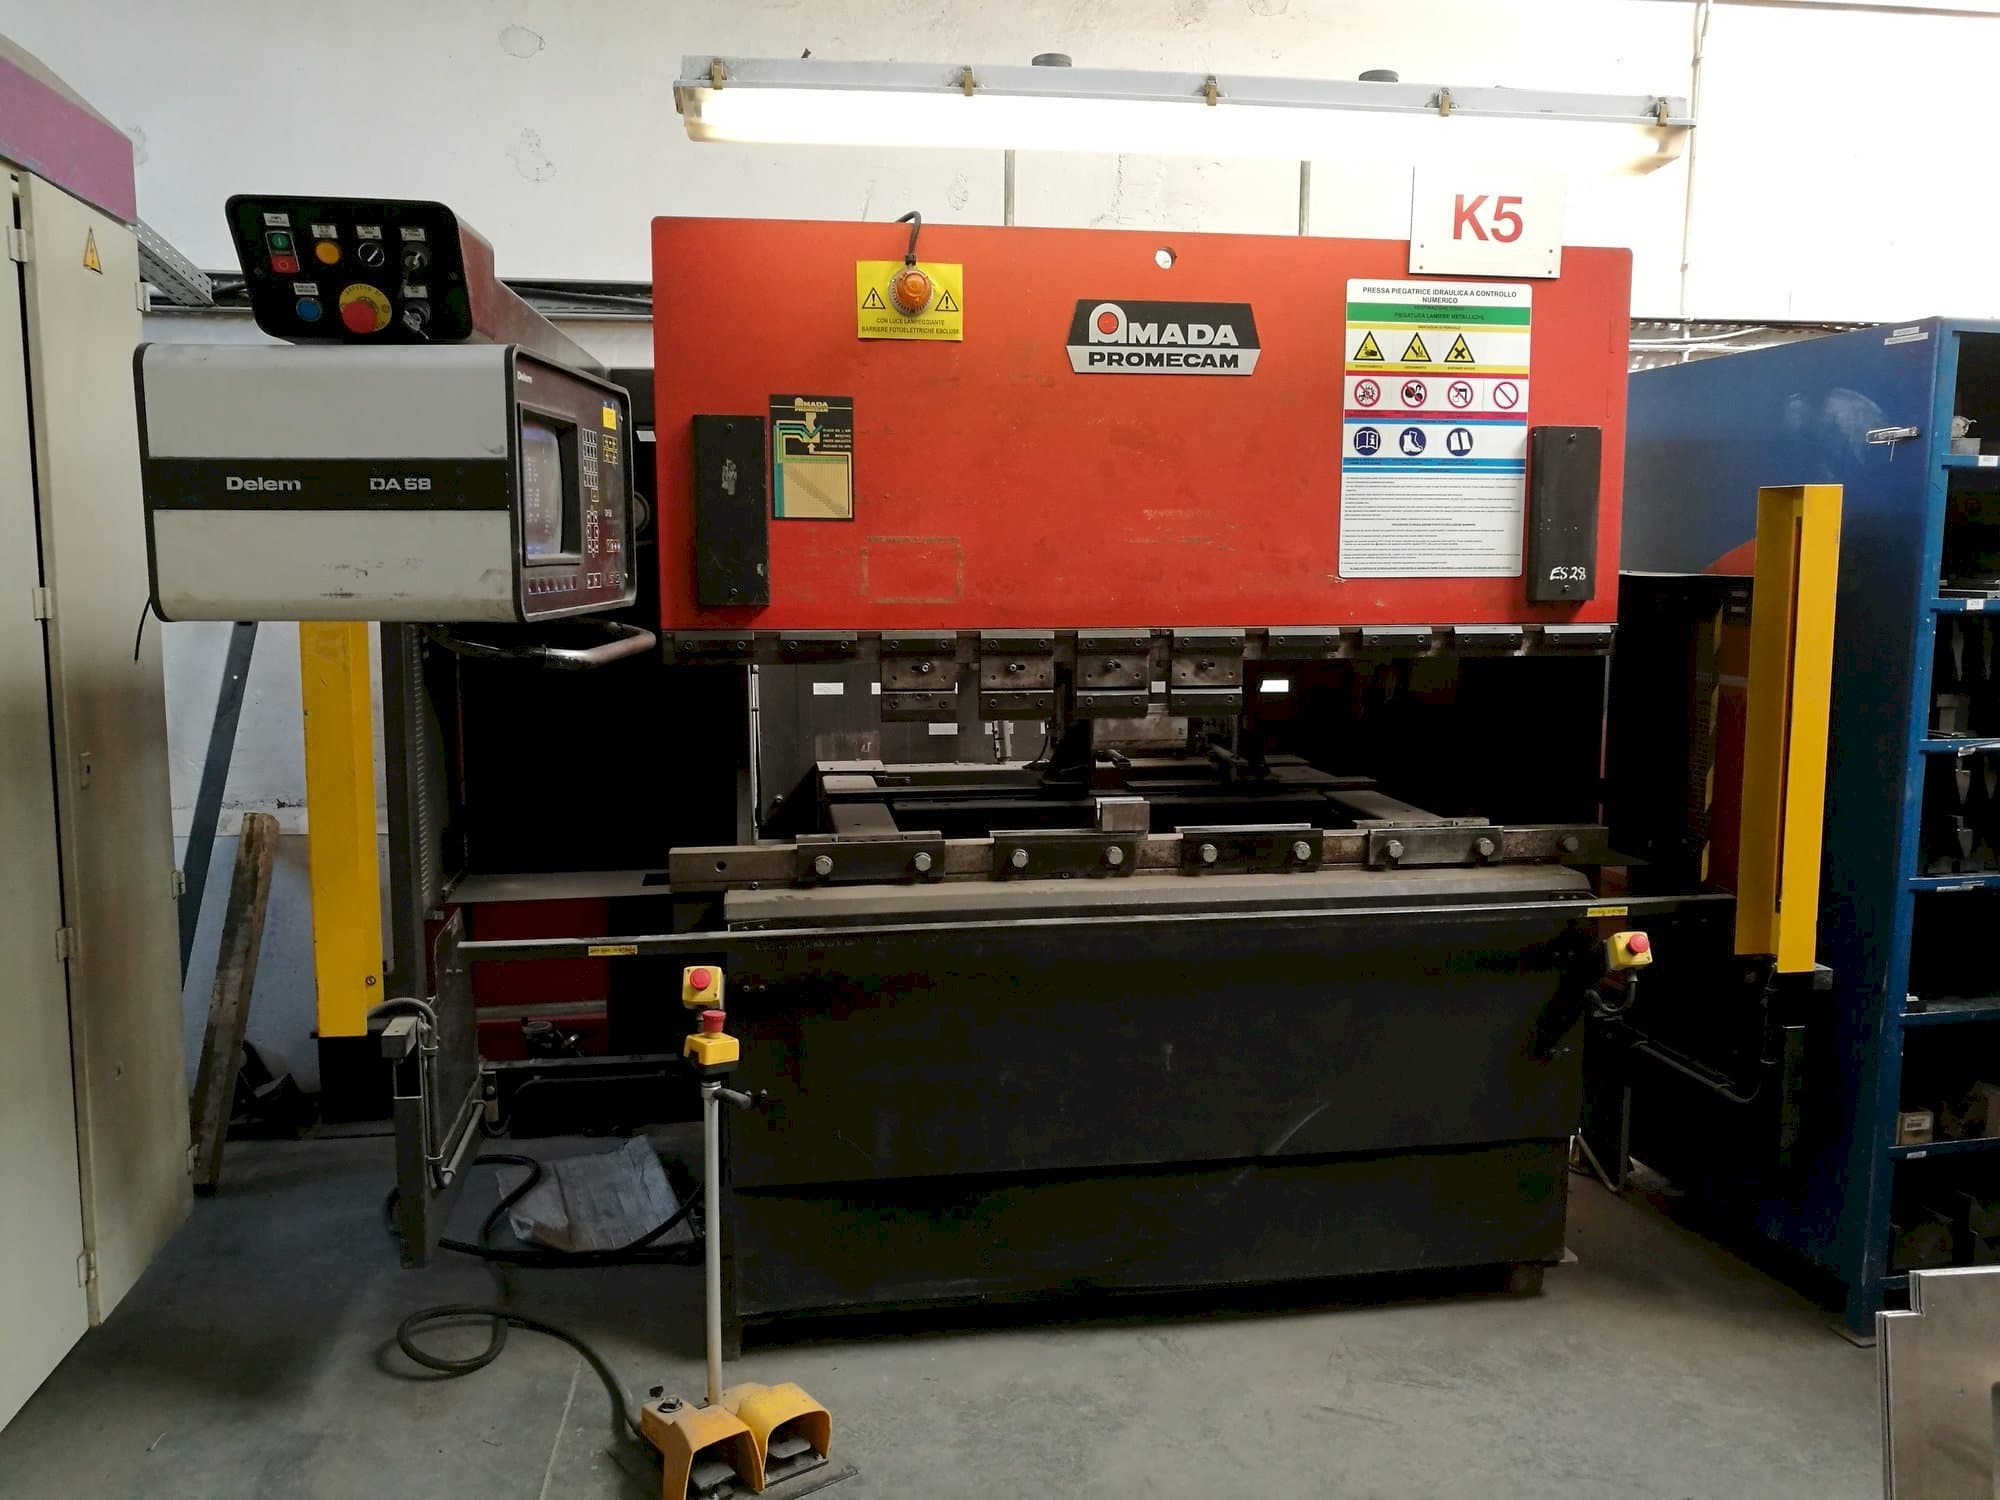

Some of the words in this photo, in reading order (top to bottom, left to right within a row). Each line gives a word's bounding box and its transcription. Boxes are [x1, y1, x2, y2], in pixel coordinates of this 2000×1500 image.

[1453, 194, 1523, 243] K5
[1362, 286, 1390, 294] PRESSA
[1391, 287, 1431, 295] PIEGATRICE
[1432, 289, 1468, 297] IDRAULICA
[1475, 290, 1517, 298] CONTROLLO
[1422, 296, 1458, 304] NUMERICO
[1089, 303, 1239, 346] AMADA
[1089, 352, 1239, 368] PROMECAM
[226, 476, 301, 491] Delem
[369, 478, 401, 490] DA
